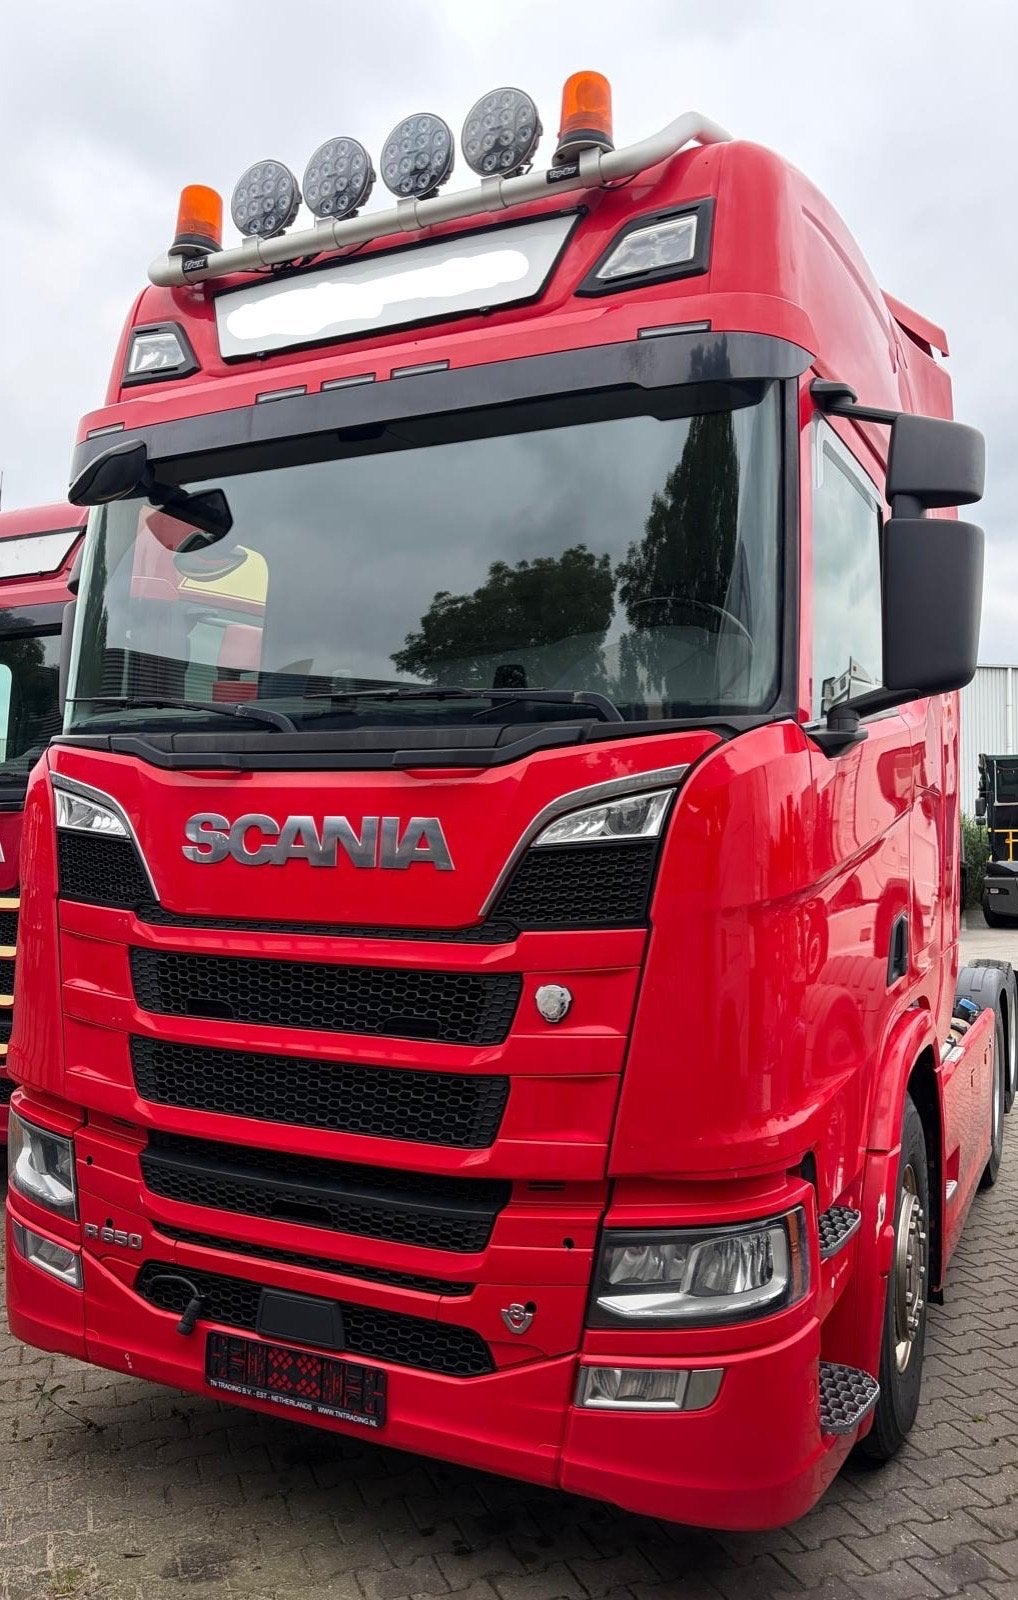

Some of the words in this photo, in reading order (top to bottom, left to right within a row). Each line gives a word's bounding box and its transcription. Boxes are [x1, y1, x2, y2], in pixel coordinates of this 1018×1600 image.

[181, 812, 456, 871] SCANIA
[84, 1222, 98, 1238] R
[101, 1226, 142, 1249] 650
[210, 1379, 218, 1387] TN
[218, 1381, 242, 1393] TRADING
[256, 1390, 267, 1399] EST
[271, 1395, 313, 1411] NETHERLANDS
[317, 1406, 378, 1427] WWW.TNTRADING.NL
